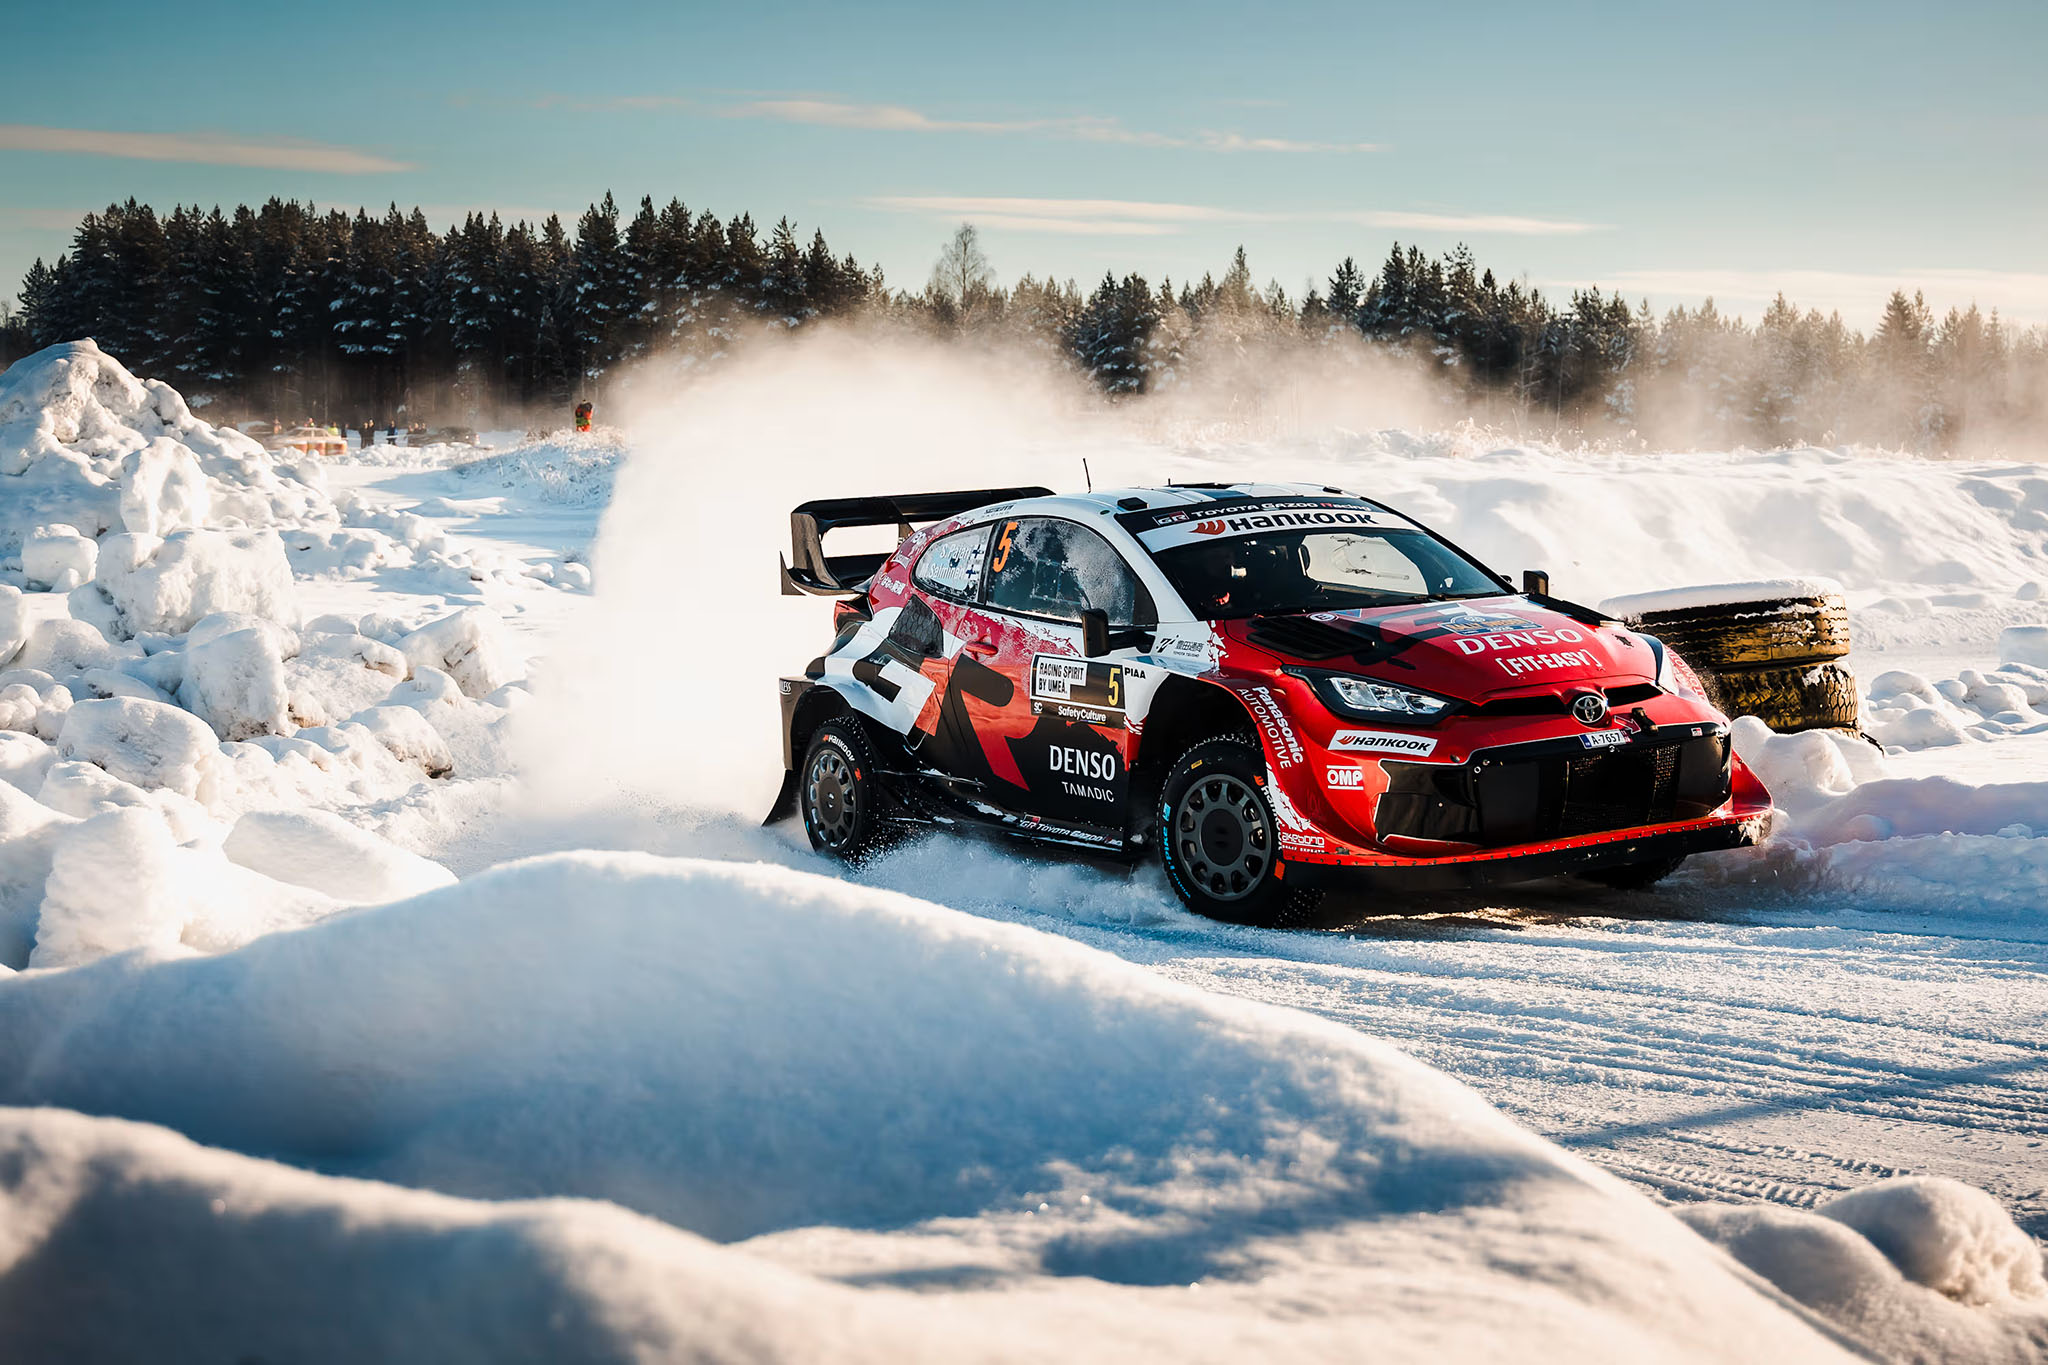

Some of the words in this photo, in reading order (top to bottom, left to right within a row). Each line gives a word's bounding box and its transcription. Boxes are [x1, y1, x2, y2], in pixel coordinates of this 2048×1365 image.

[1158, 512, 1187, 525] GR
[1191, 505, 1260, 517] TOYOTA
[993, 522, 1018, 573] 5
[1453, 629, 1583, 655] DENSO
[1039, 663, 1062, 678] RACING
[1063, 666, 1084, 680] SPIRIT
[1125, 667, 1146, 679] PIAA
[1039, 678, 1047, 690] BY
[1108, 667, 1120, 706] 5
[1058, 705, 1107, 722] SafetyCulture
[1237, 688, 1292, 769] AUTOMOTIVE
[1252, 686, 1304, 764] Panasonic
[1591, 732, 1621, 745] A-7657
[1050, 744, 1116, 781] DENSO
[1327, 769, 1363, 786] OMP
[1061, 781, 1115, 802] TAMADIC
[1038, 823, 1070, 836] TOYOTA
[1281, 832, 1325, 846] akebono
